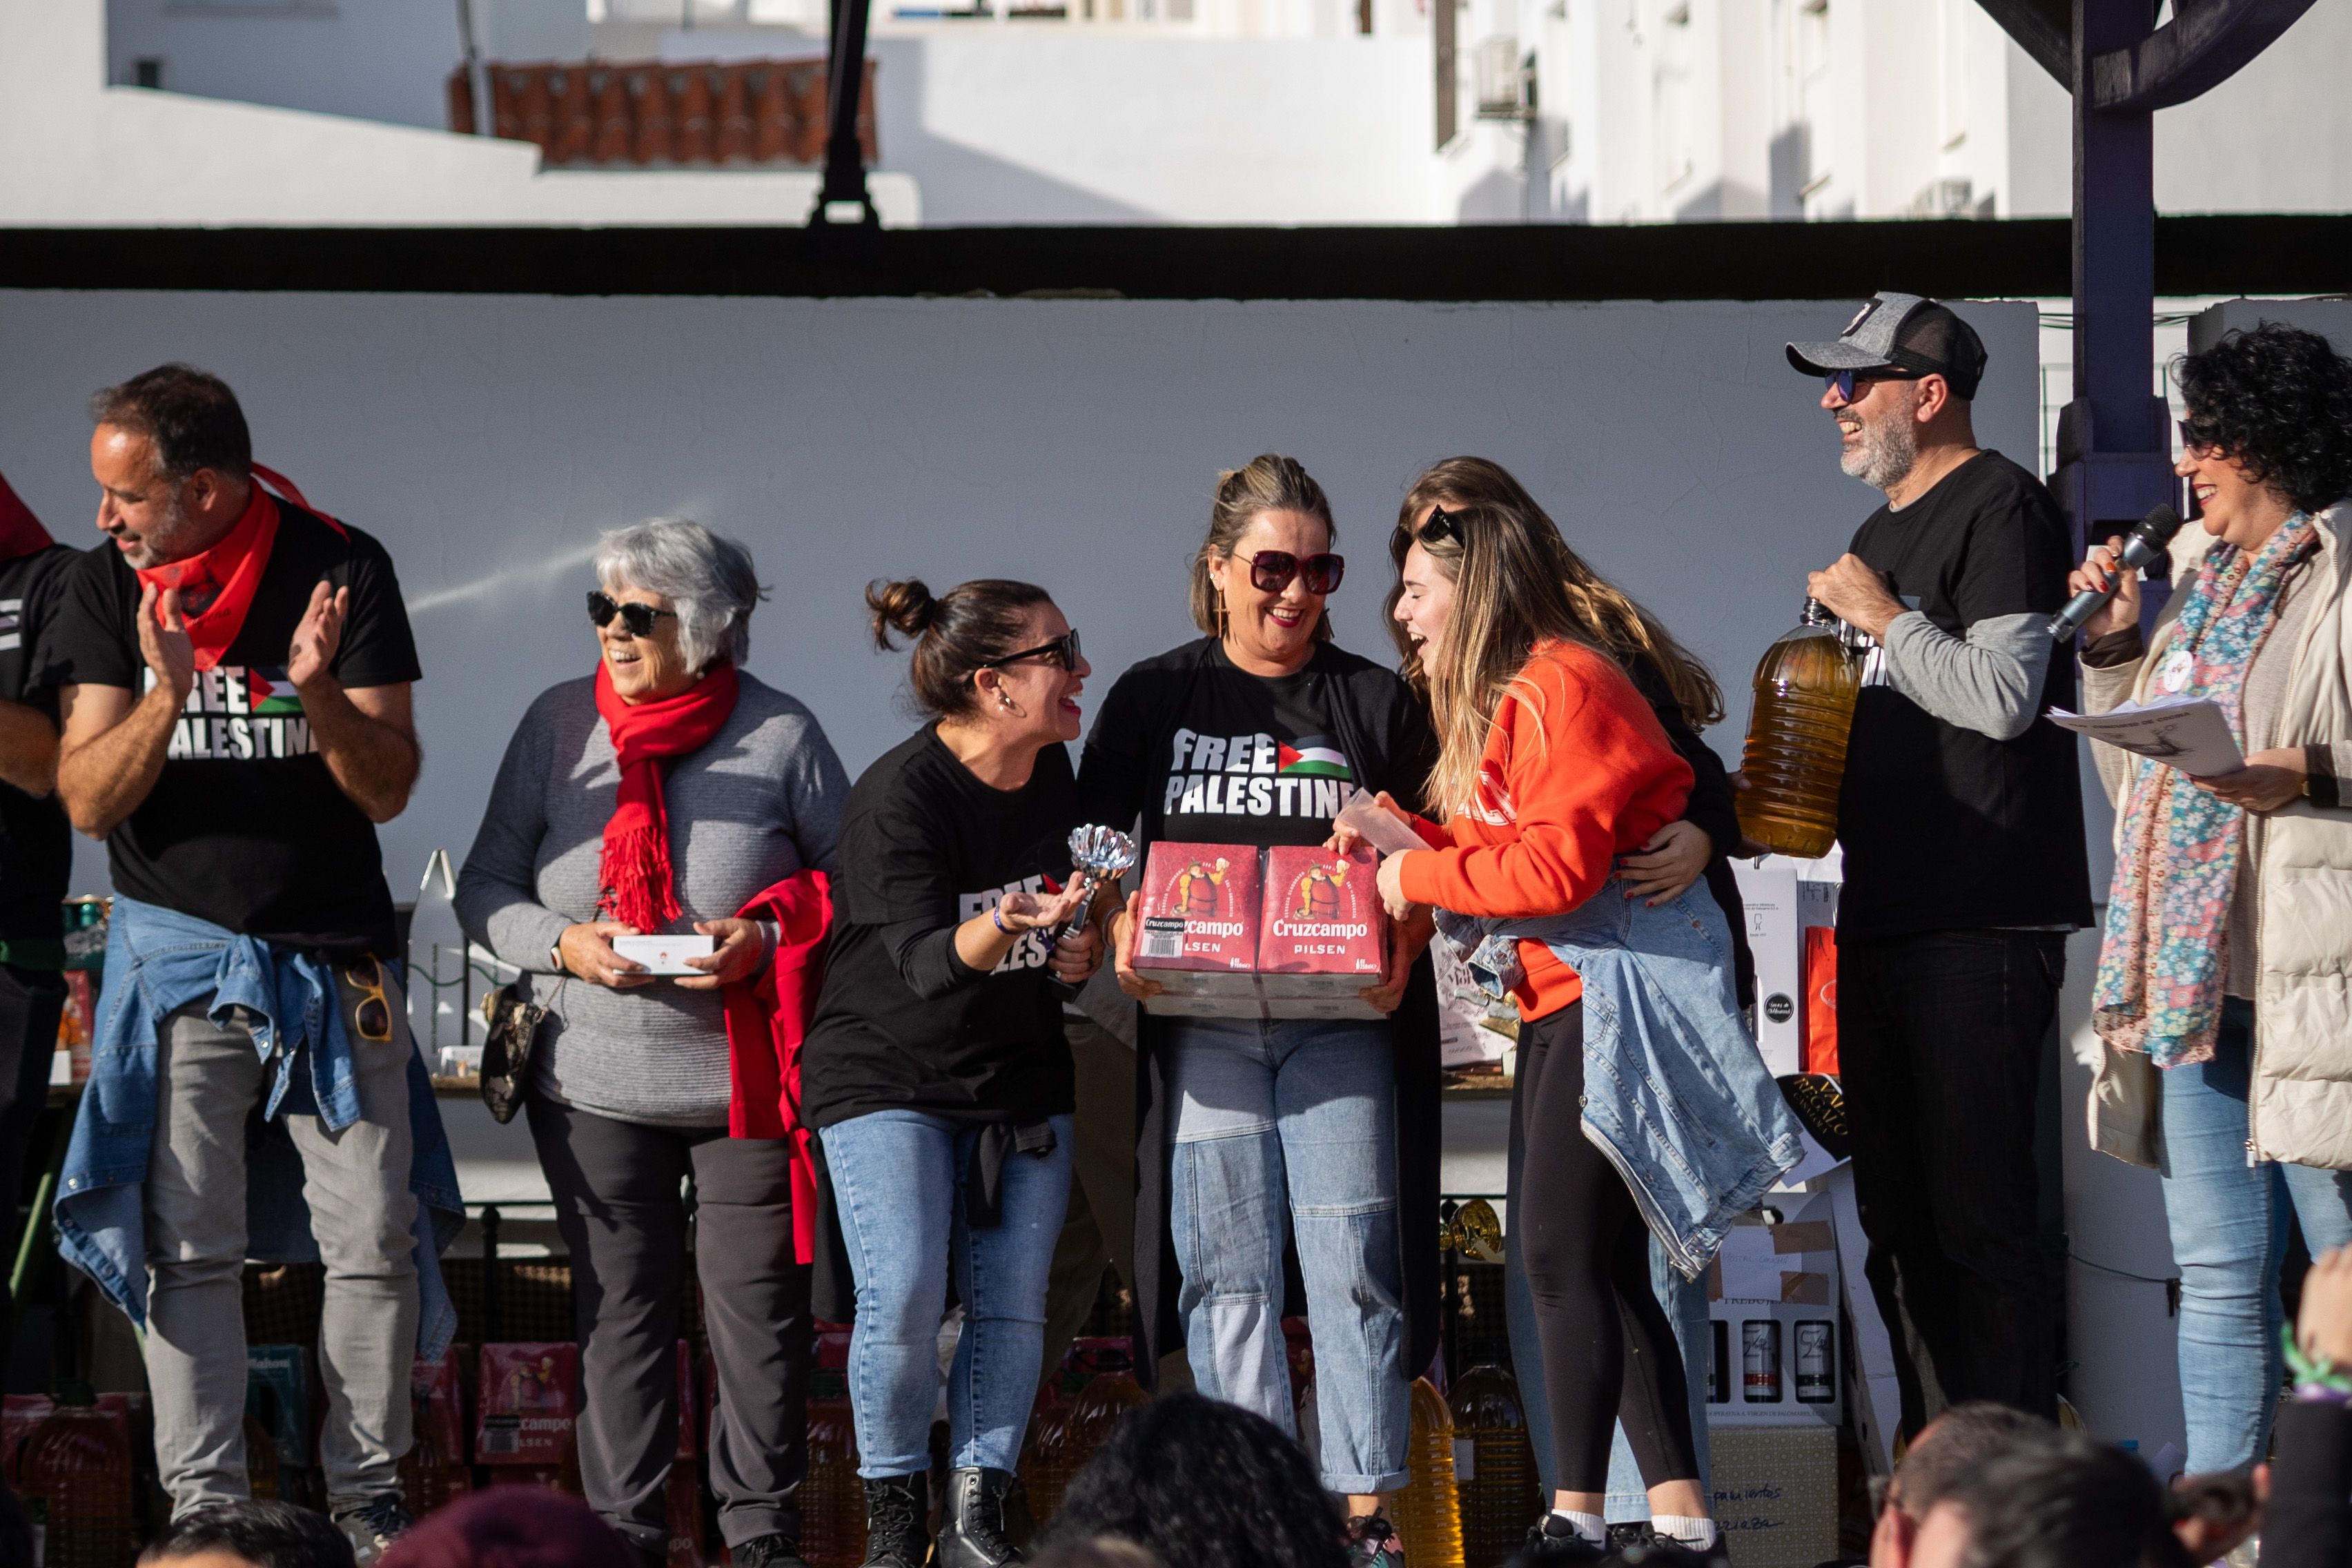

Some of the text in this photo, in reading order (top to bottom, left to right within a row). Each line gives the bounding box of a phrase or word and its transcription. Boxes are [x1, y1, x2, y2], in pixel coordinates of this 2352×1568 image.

[144, 666, 248, 714] REE
[167, 716, 320, 760] ALESTIN
[1170, 727, 1276, 774] FREE
[1146, 919, 1184, 929] Cruzcampo
[1184, 919, 1243, 939] campo
[1273, 919, 1368, 940] Cruzcampo
[1185, 942, 1221, 952] LSEN
[1294, 944, 1346, 954] PILSEN
[519, 1418, 572, 1433] campo
